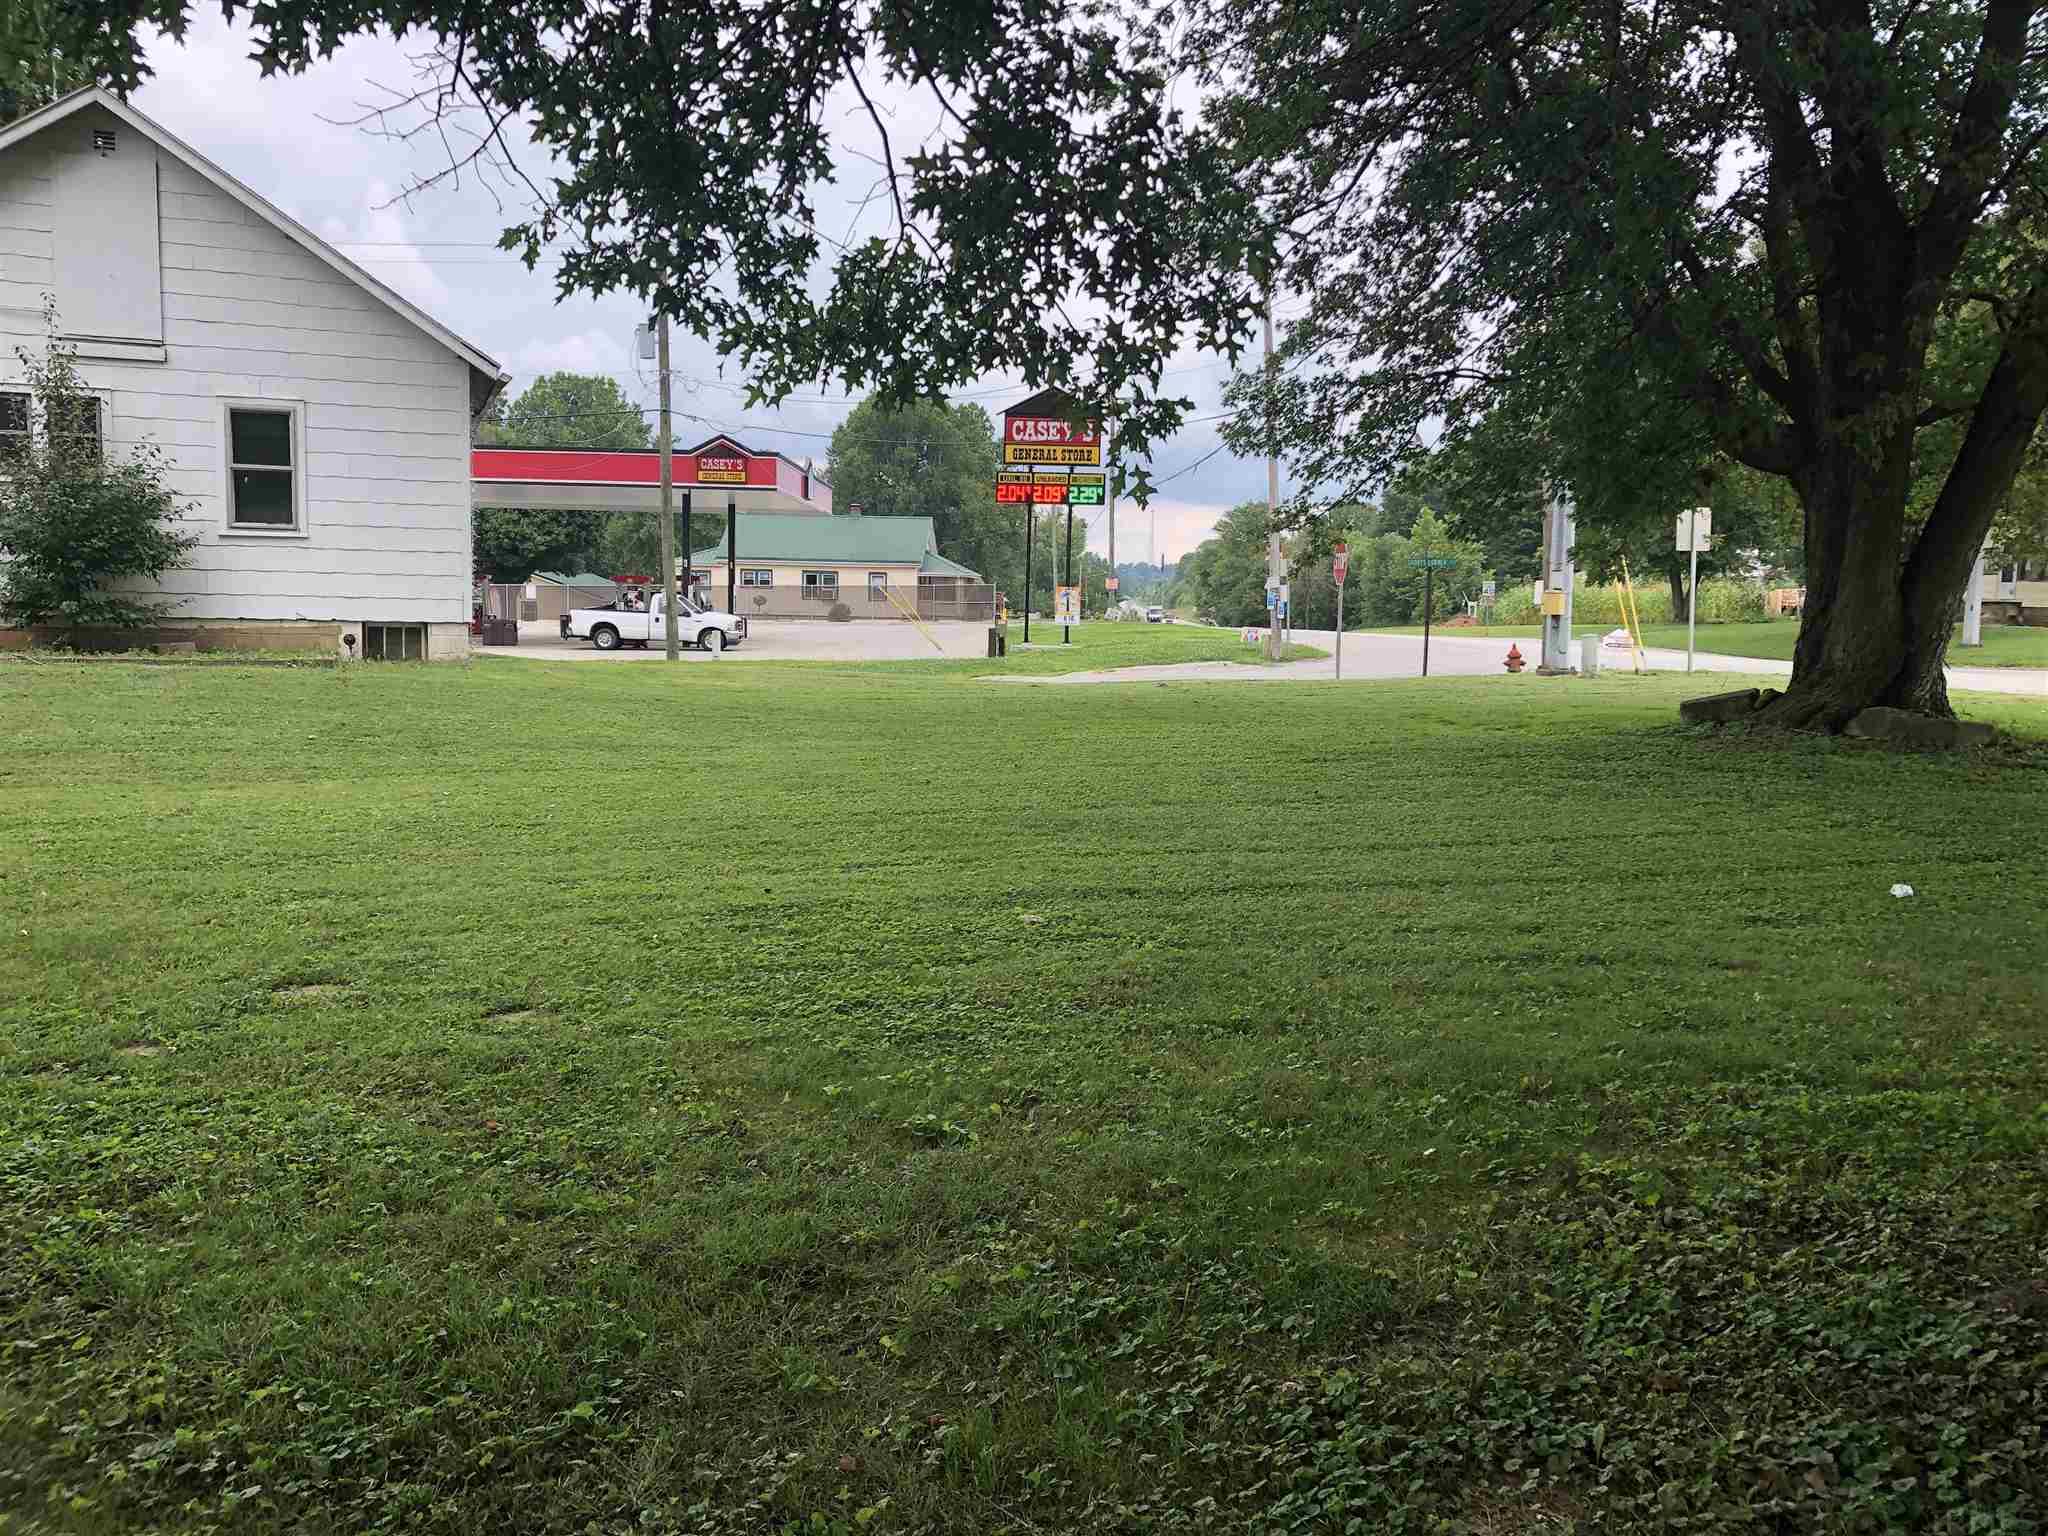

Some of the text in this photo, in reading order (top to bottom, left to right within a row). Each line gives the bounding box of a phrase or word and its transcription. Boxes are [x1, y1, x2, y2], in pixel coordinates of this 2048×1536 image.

[1013, 448, 1093, 462] GENERAL STORE
[701, 458, 743, 469] CASEY'S
